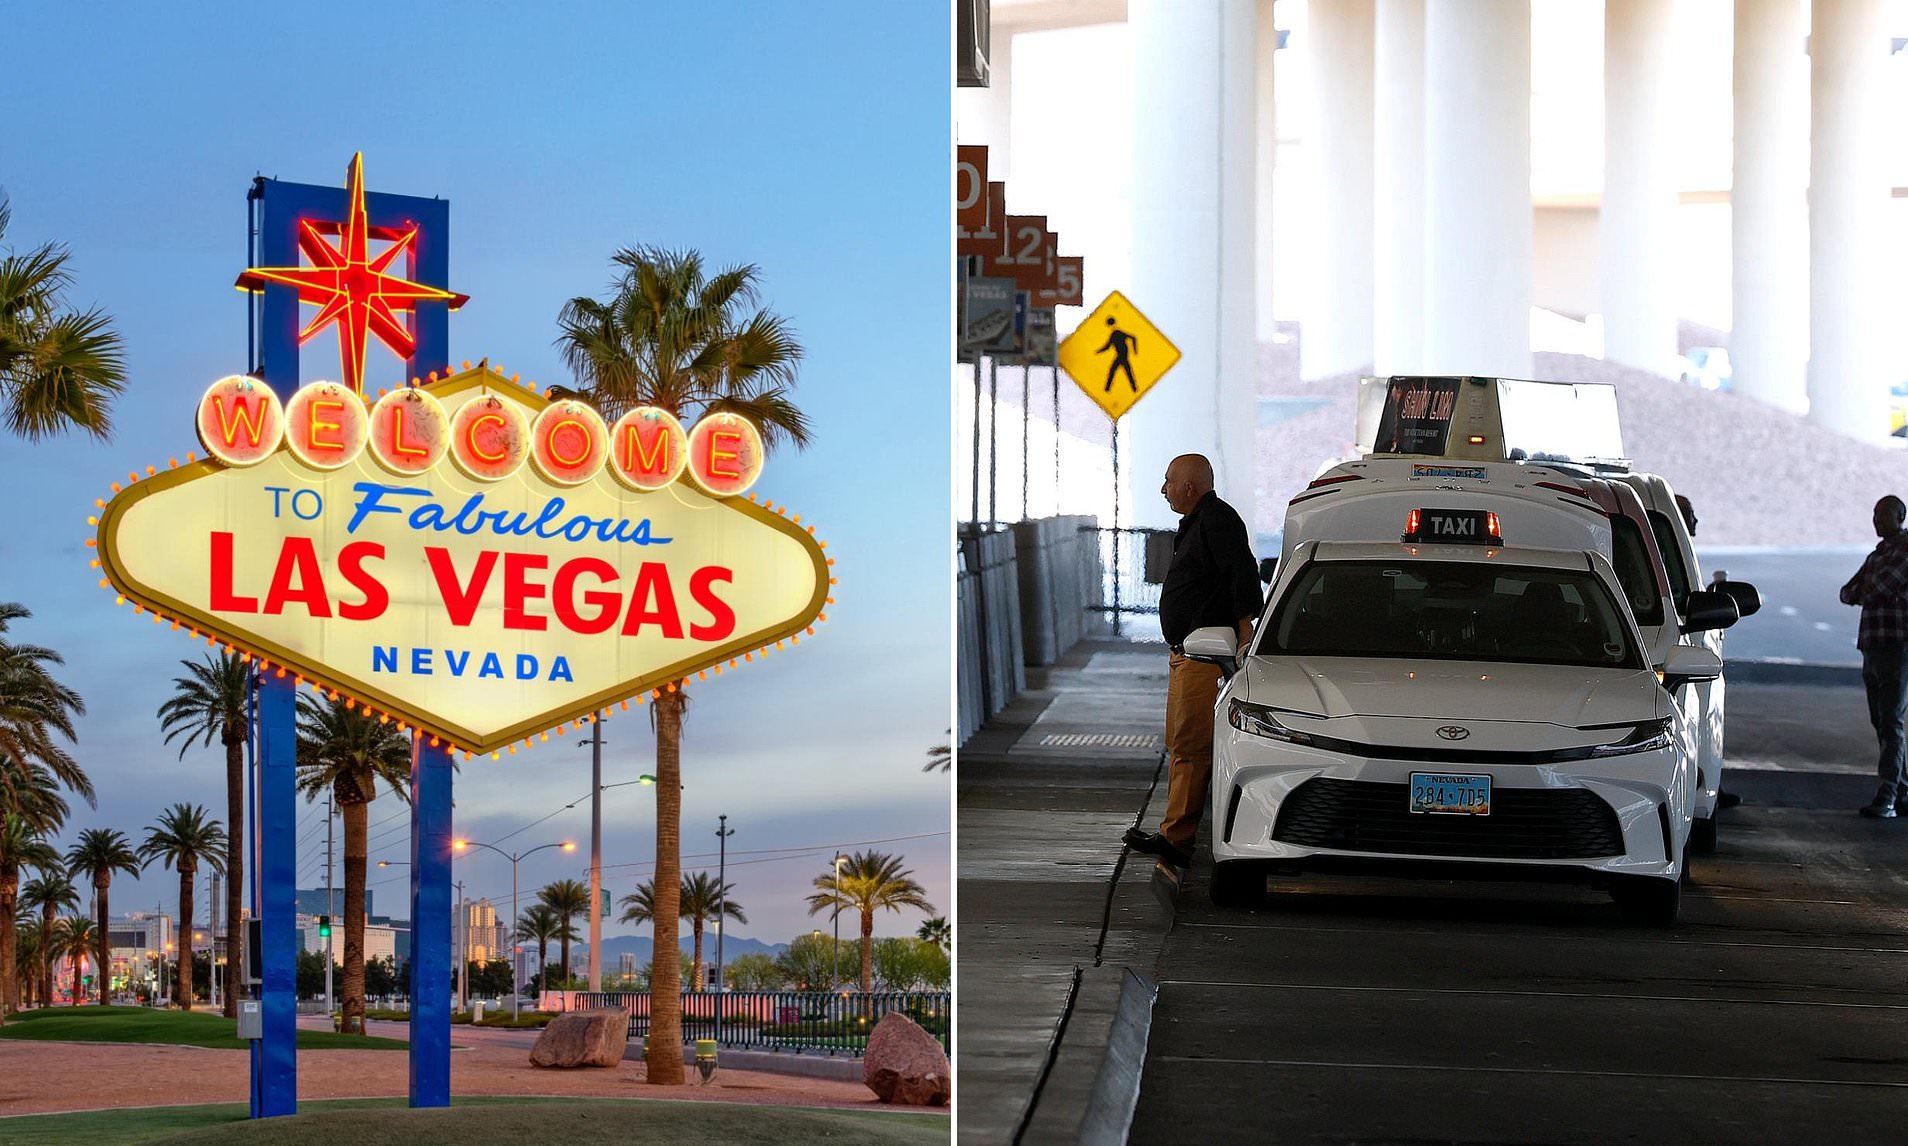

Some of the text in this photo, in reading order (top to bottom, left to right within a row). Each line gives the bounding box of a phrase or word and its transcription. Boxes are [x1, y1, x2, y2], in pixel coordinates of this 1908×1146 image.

[211, 393, 742, 479] WELCOME
[264, 481, 674, 546] TO Fabulous
[1431, 516, 1476, 536] TAXI
[209, 531, 737, 642] LAS VEGAS
[372, 645, 575, 683] NEVADA
[1431, 776, 1471, 785] NEVADA
